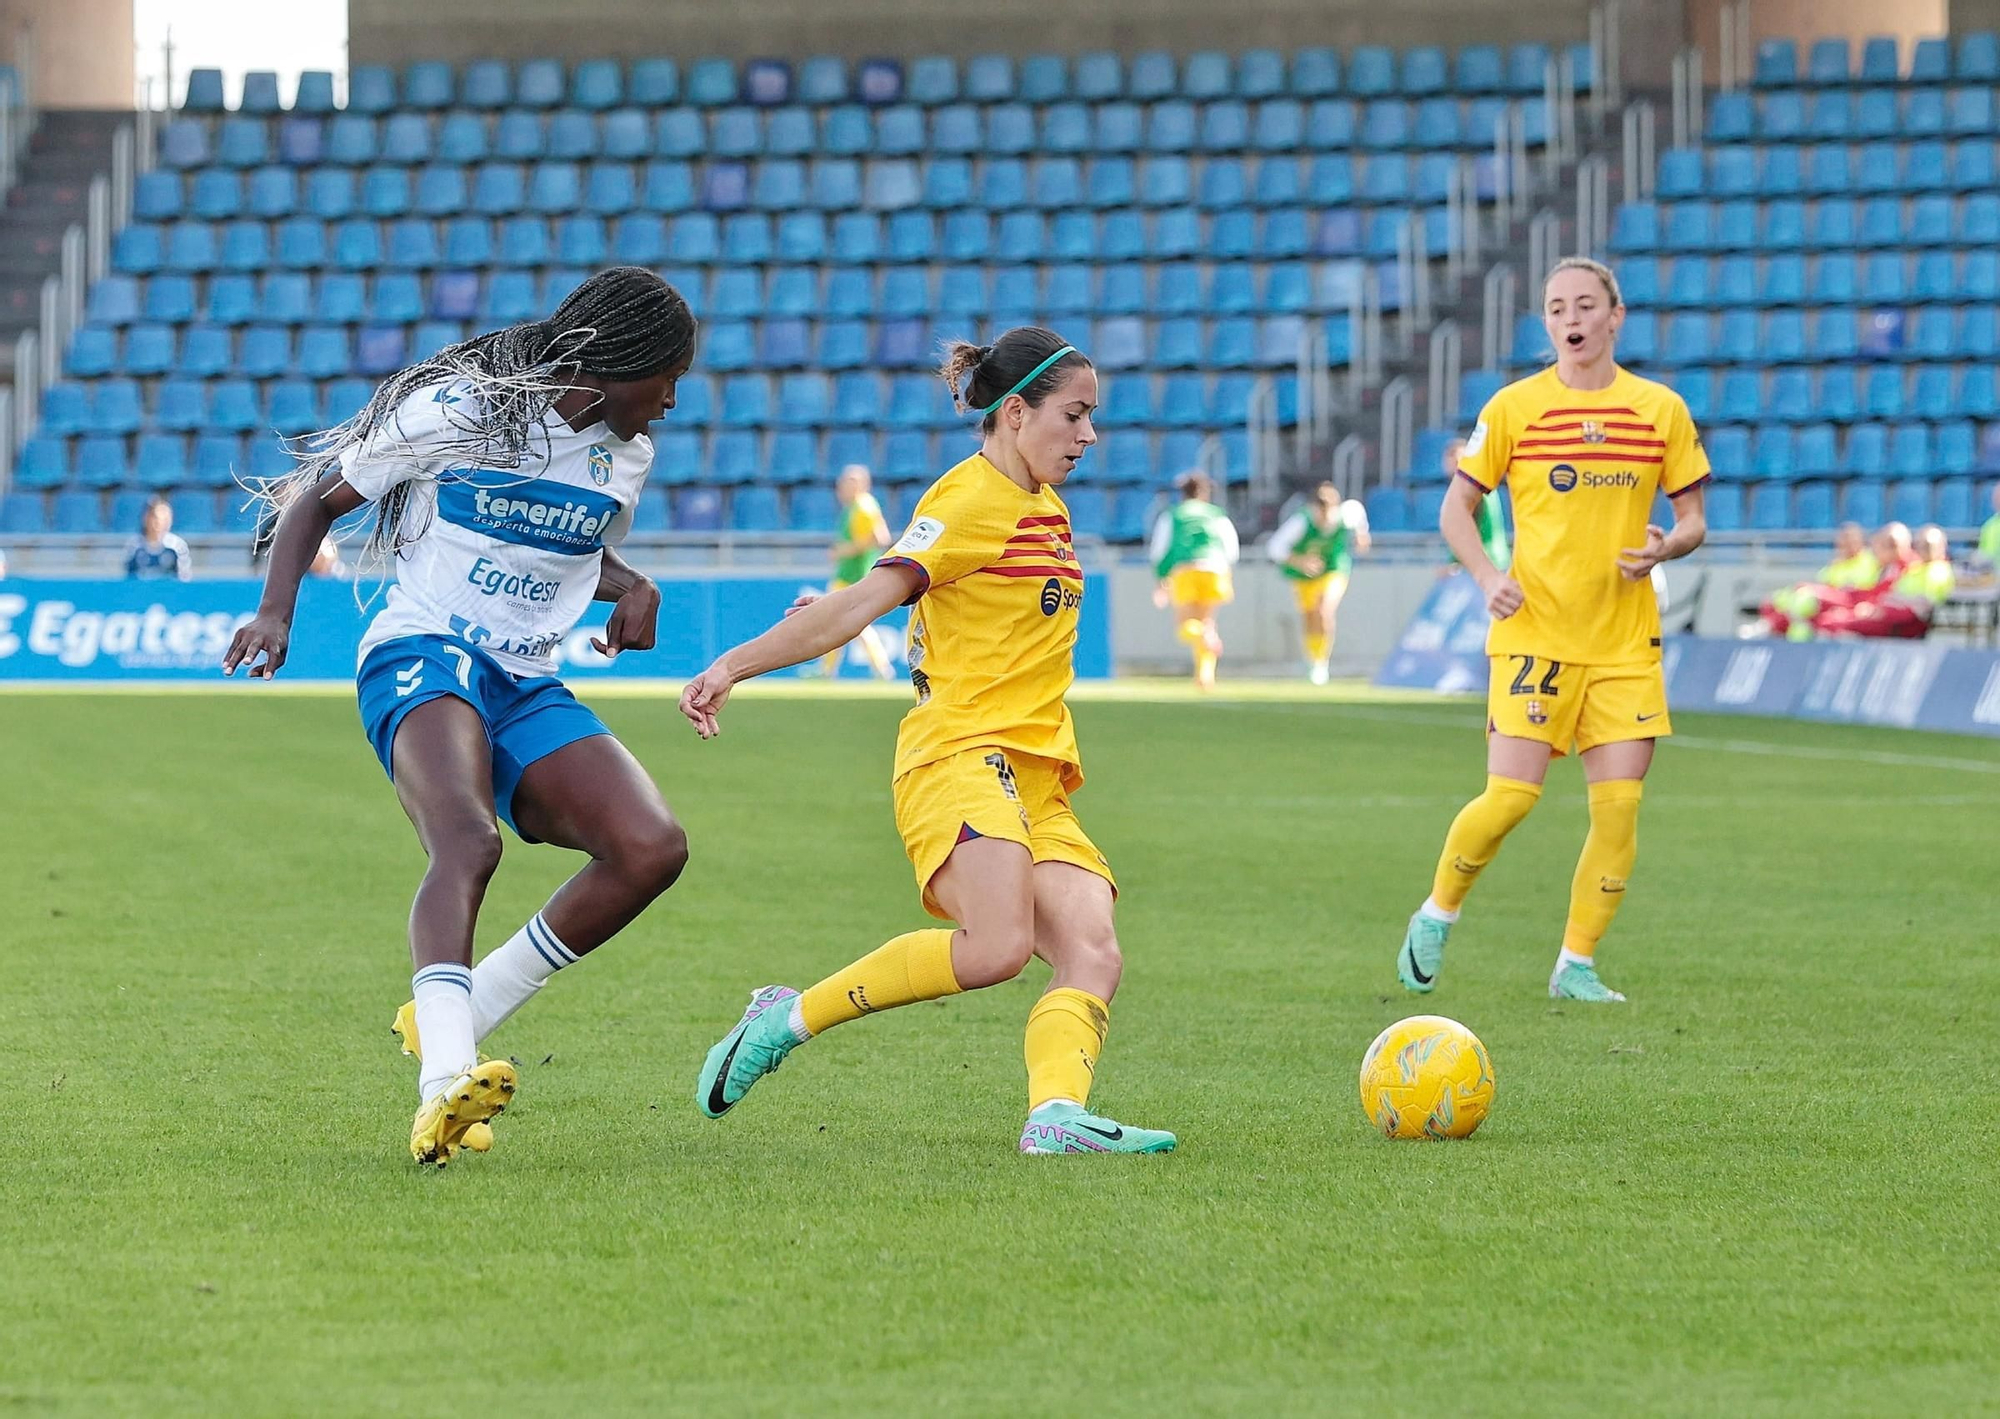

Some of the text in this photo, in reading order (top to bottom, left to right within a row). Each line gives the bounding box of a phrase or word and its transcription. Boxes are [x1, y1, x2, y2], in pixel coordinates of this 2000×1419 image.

[1582, 471, 1640, 490] Spotify
[472, 515, 530, 533] despierta
[467, 557, 561, 603] Egatesa
[443, 644, 472, 691] 7
[1509, 654, 1560, 697] 22
